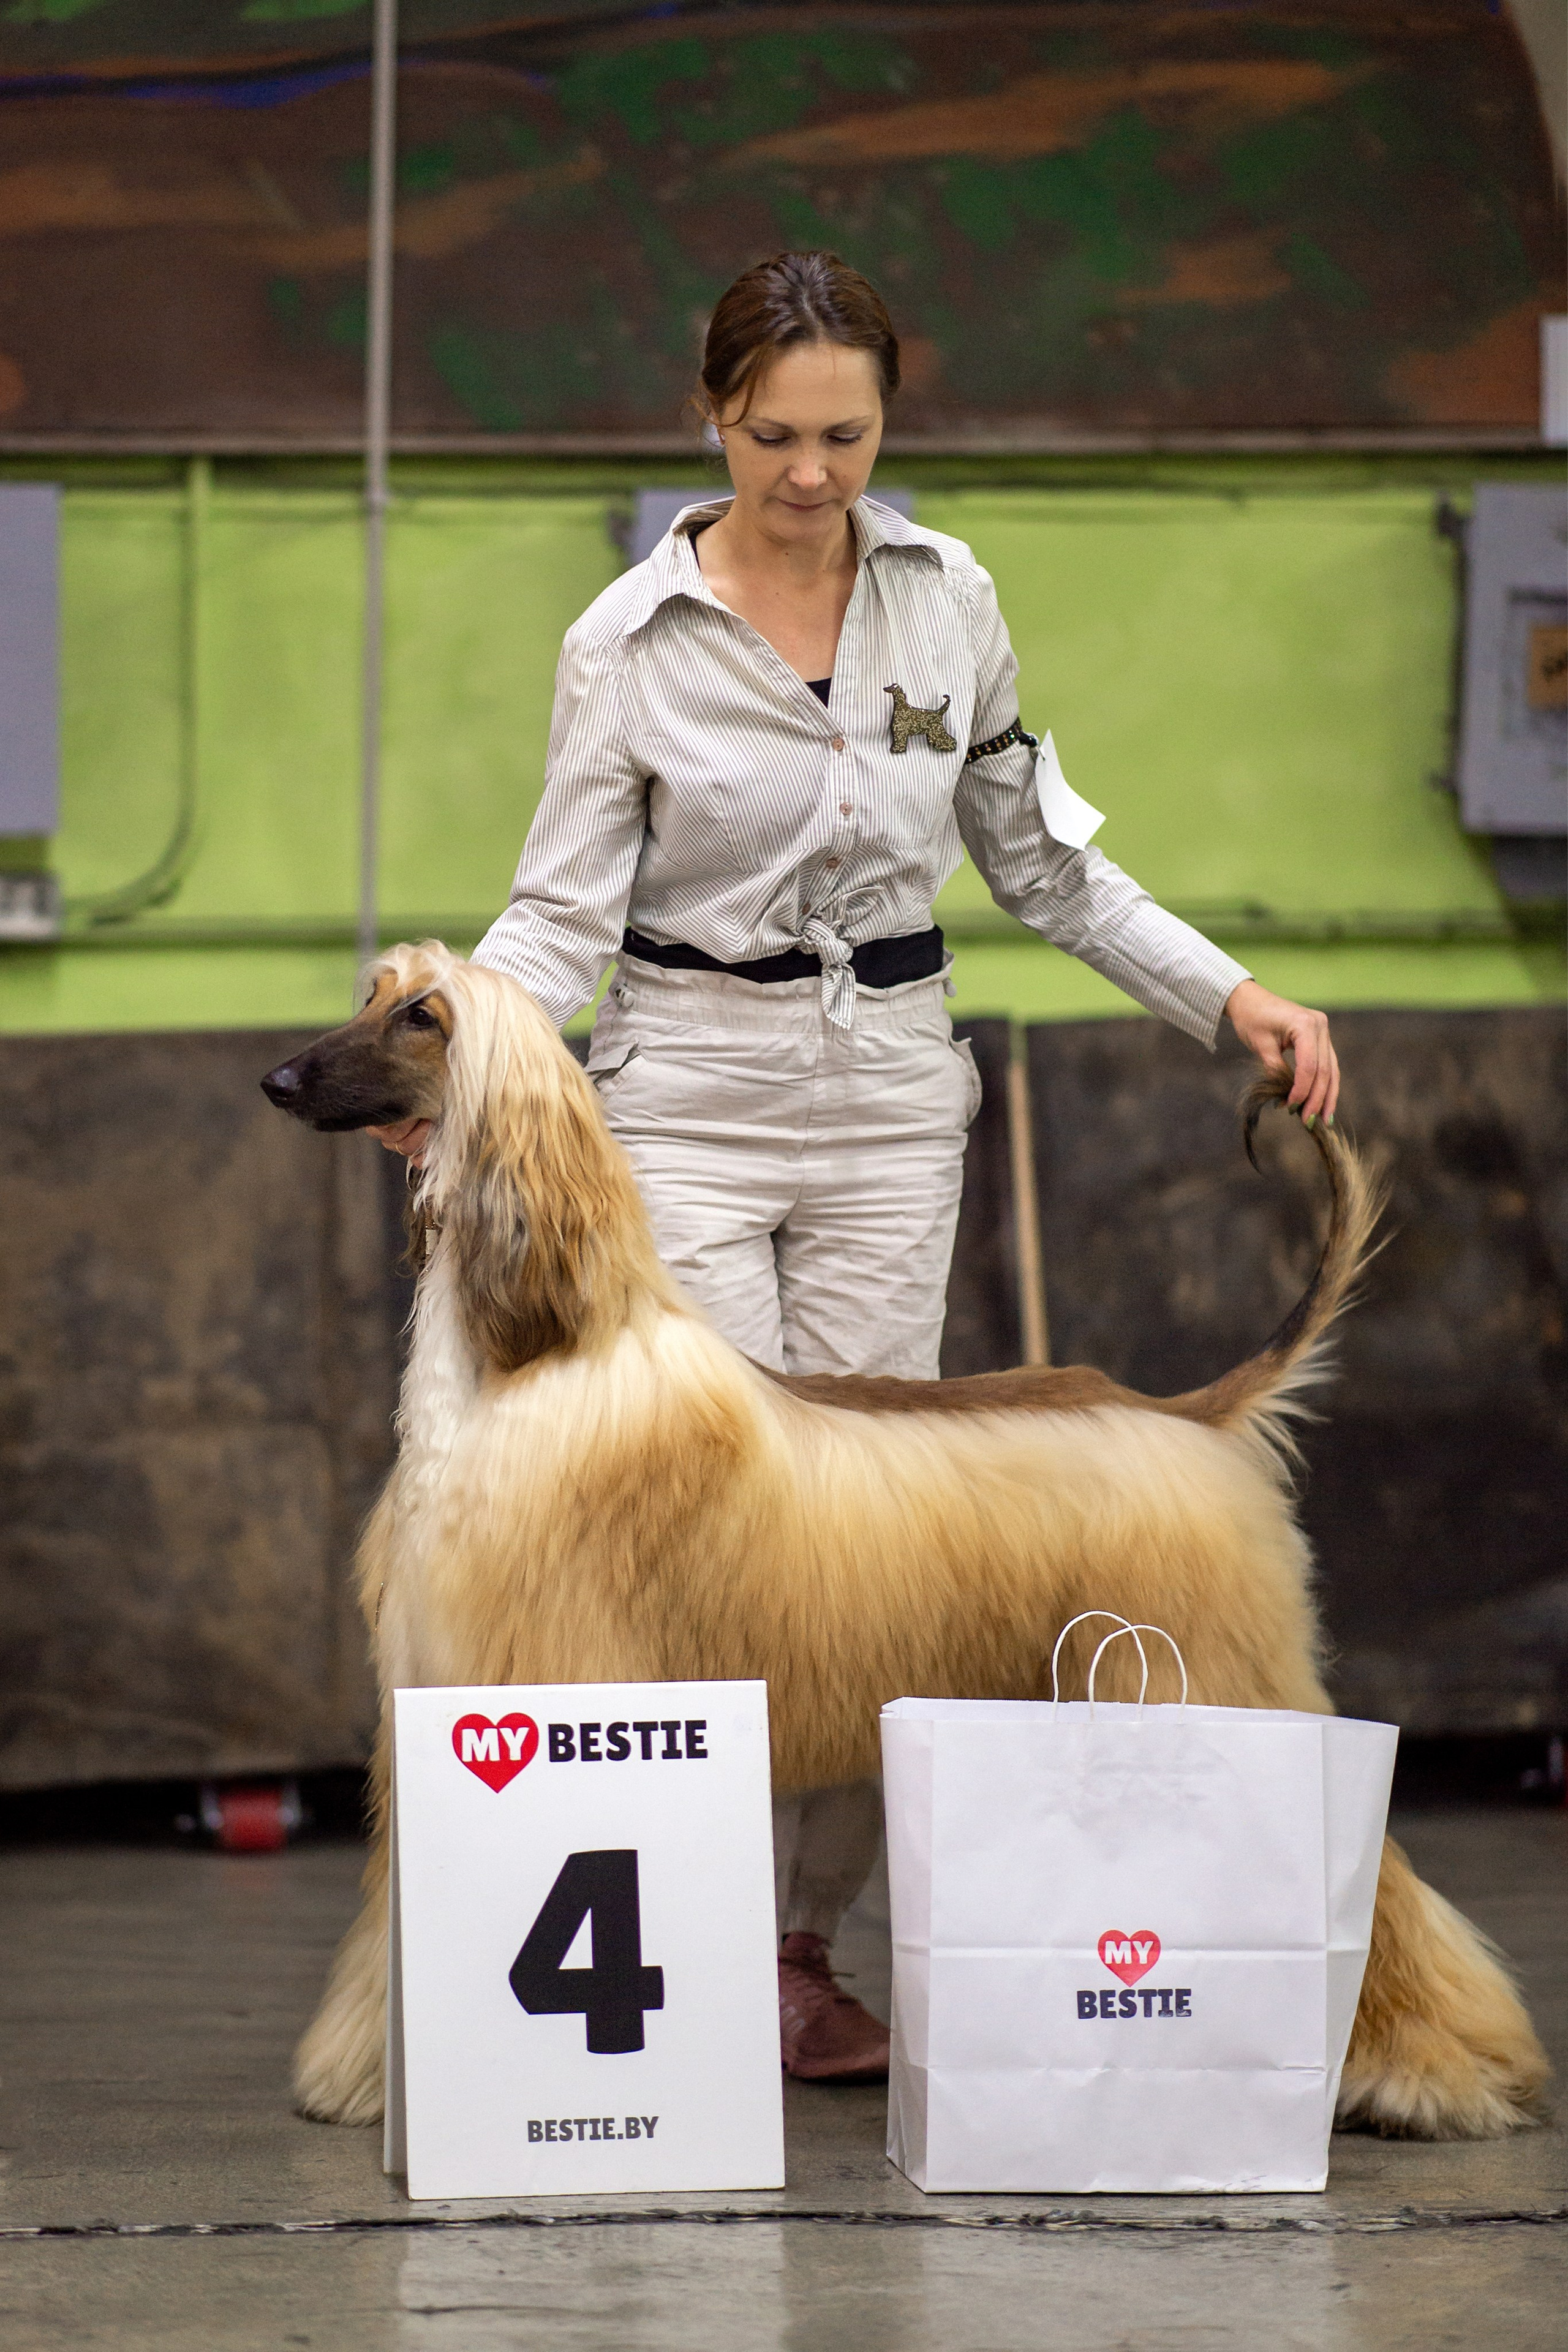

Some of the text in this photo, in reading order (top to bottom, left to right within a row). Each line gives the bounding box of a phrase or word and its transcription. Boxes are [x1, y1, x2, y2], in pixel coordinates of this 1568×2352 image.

[462, 1719, 708, 1762] MY BESTIE
[508, 1849, 665, 2054] 4
[1104, 1940, 1153, 1964] MY
[1077, 1988, 1192, 2019] BESTIE
[527, 2116, 659, 2143] BESTIE.BY
